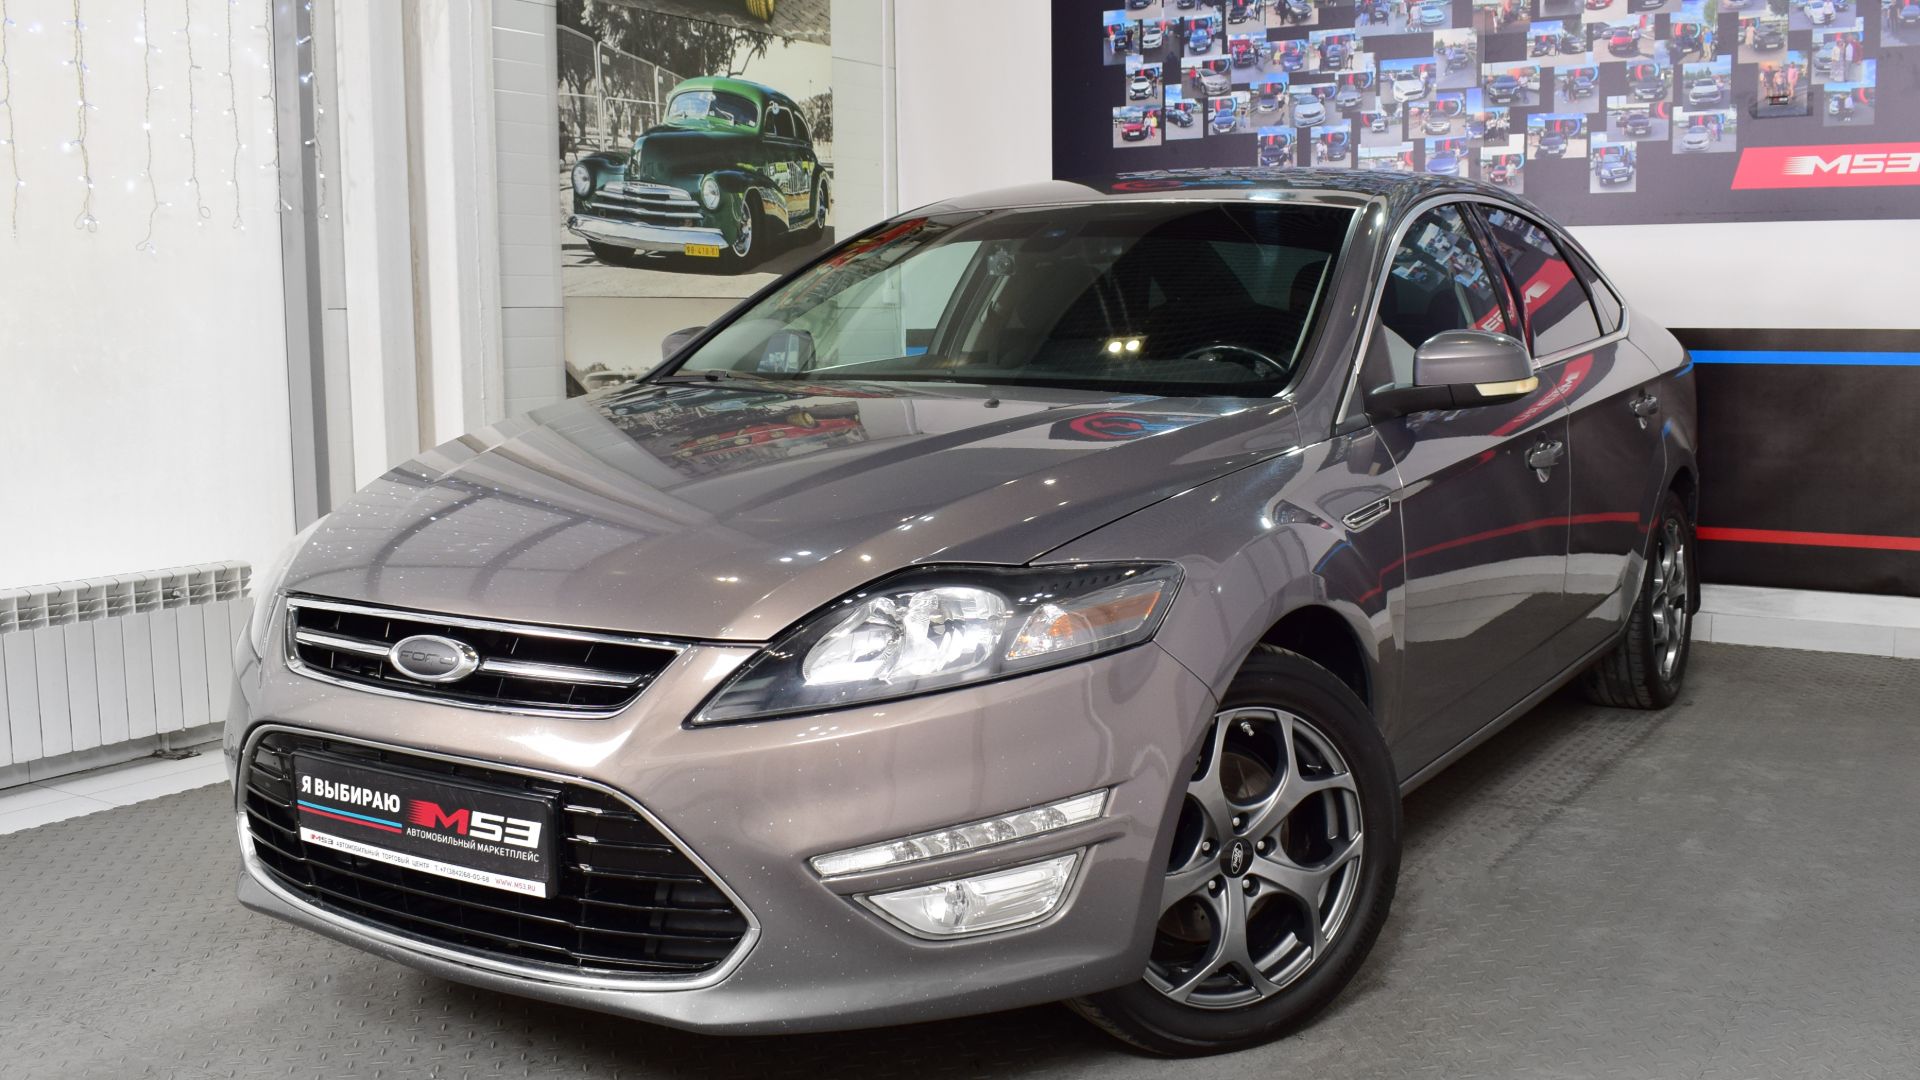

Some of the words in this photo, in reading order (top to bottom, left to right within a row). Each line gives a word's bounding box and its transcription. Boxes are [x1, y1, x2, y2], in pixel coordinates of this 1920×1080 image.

[1784, 152, 1920, 176] M53
[301, 775, 312, 794] Я
[314, 777, 401, 813] ВЫБИРАЮ
[407, 799, 542, 849] M53
[336, 841, 380, 857] АВТОМОБИЛЬНЫЙ
[382, 852, 410, 864] ТОРГОВЫЙ
[406, 827, 476, 850] АВТОМОБИЛЬНЫЙ
[477, 843, 540, 863] МАРКЕТПЛЕЙС
